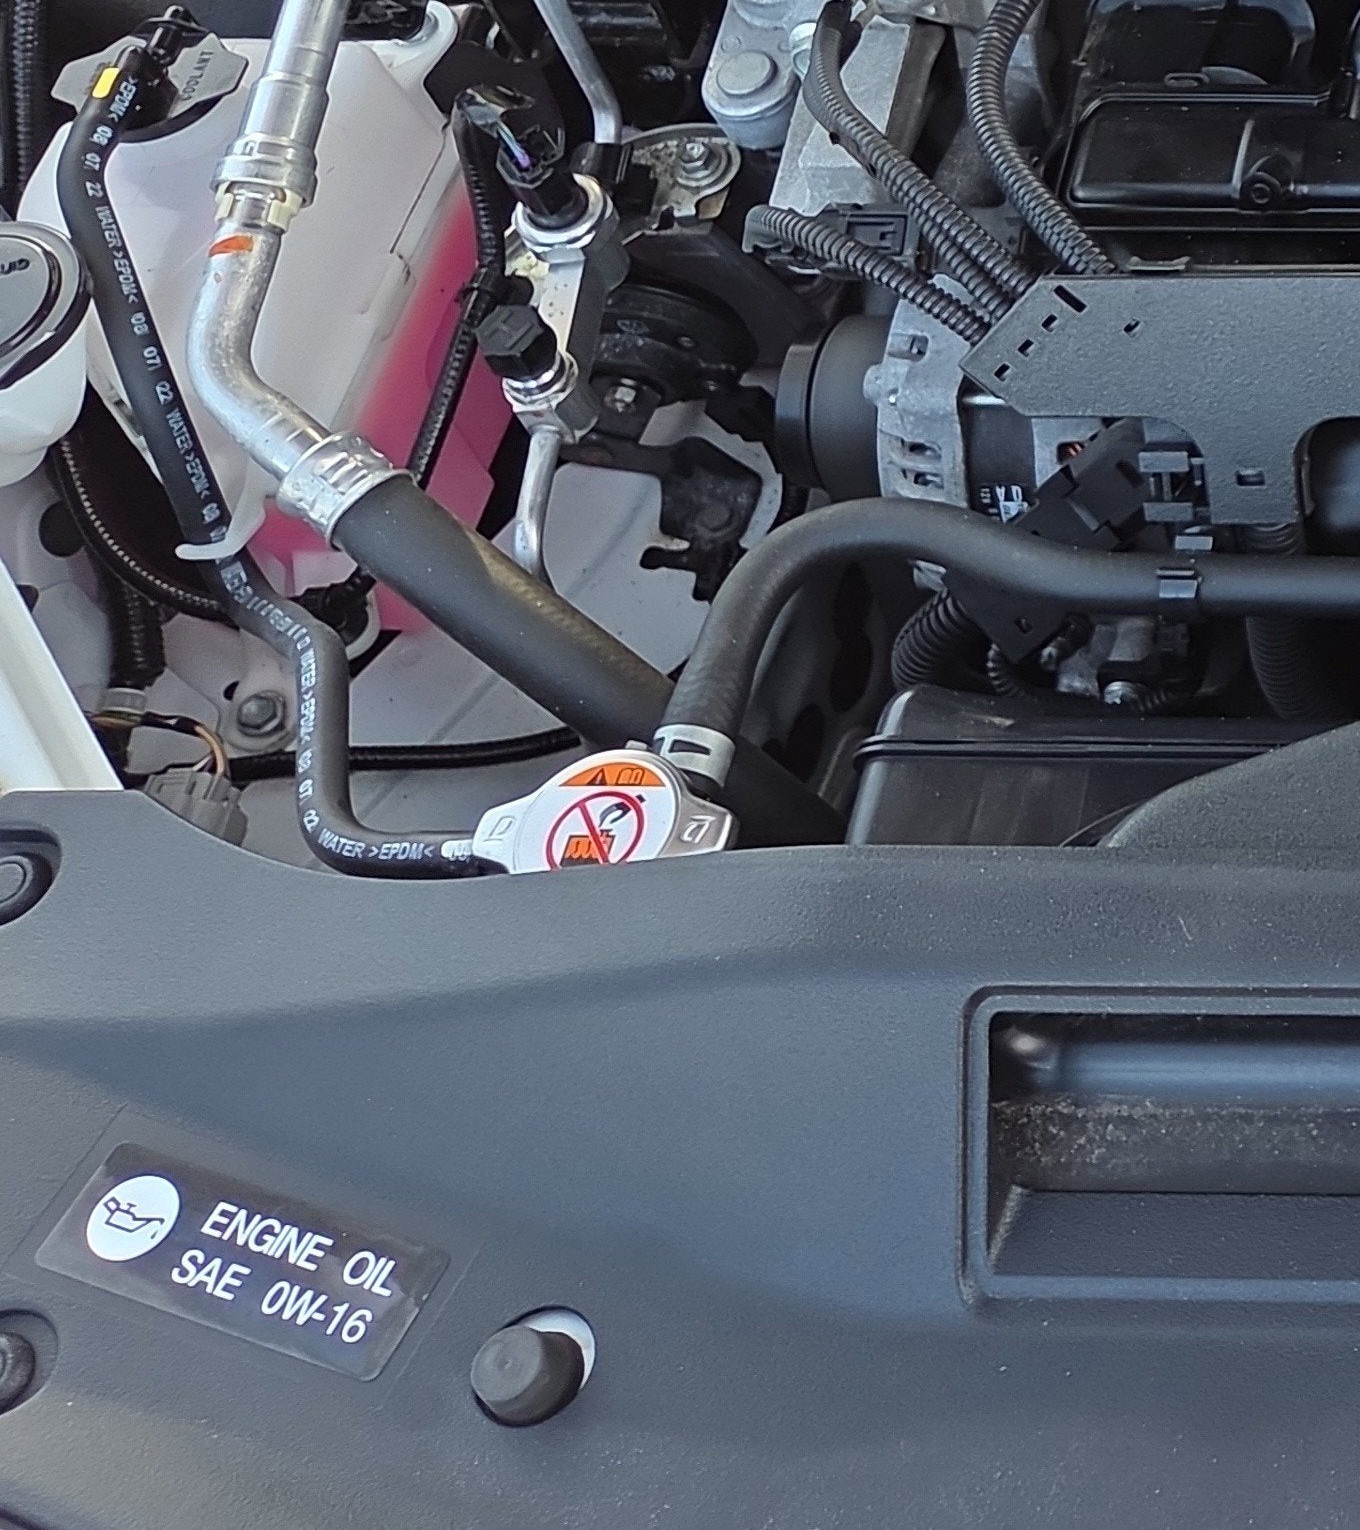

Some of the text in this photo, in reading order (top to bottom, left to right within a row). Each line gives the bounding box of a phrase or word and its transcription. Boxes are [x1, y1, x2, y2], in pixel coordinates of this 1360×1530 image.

[181, 50, 215, 102] COOLANT
[85, 181, 104, 199] 22
[95, 205, 123, 249] WATER
[166, 407, 194, 455] WATER
[316, 827, 366, 859] WATER
[171, 1249, 373, 1344] SAE 0W-16
[201, 1201, 397, 1298] ENGINE OIL
